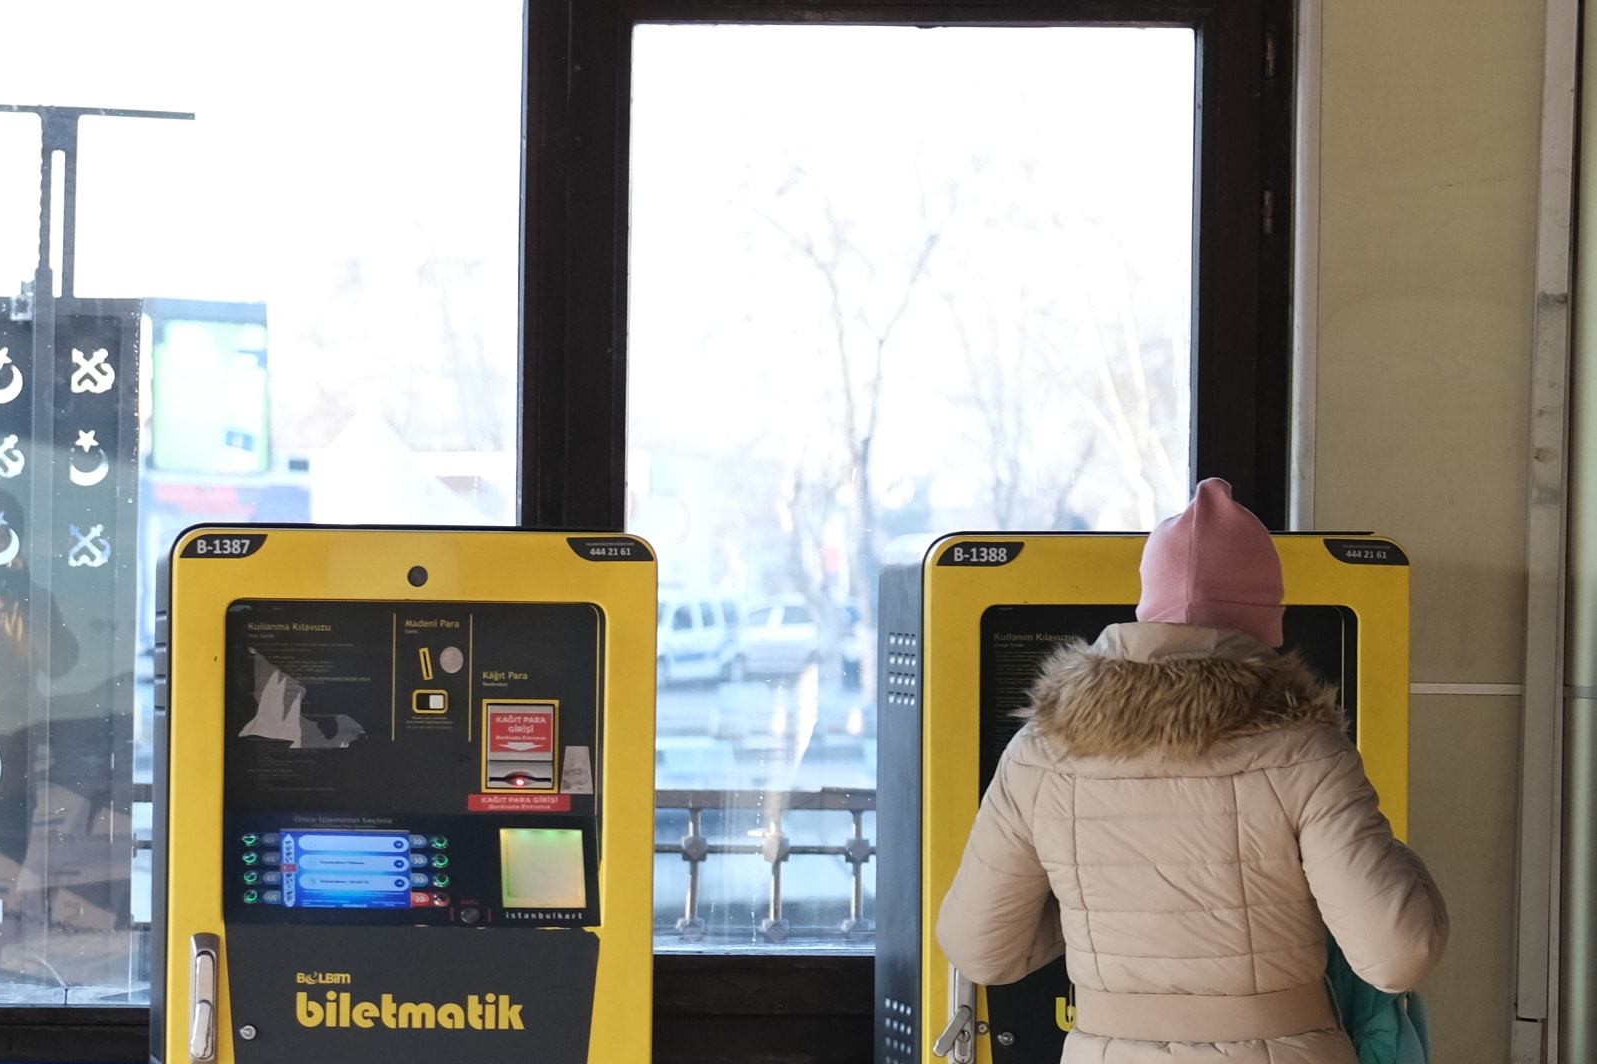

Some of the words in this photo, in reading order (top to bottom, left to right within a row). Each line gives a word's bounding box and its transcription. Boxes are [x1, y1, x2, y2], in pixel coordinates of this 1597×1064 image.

[196, 539, 251, 555] B-1387
[589, 548, 605, 556] 444
[608, 548, 618, 556] 21
[620, 548, 631, 556] 61
[953, 546, 1008, 563] B-1388
[1346, 550, 1361, 558] 444
[1364, 551, 1374, 559] 21
[1376, 551, 1387, 559] 61
[248, 622, 290, 631] Kullanma
[405, 619, 438, 628] Madeni
[440, 619, 460, 628] Para
[508, 671, 528, 680] Para
[496, 716, 522, 724] KAĞIT
[508, 725, 534, 734] GİRİŞİ
[481, 796, 507, 804] KAĞIT
[533, 796, 559, 805] GİRİŞİ
[296, 990, 526, 1030] biletmatik
